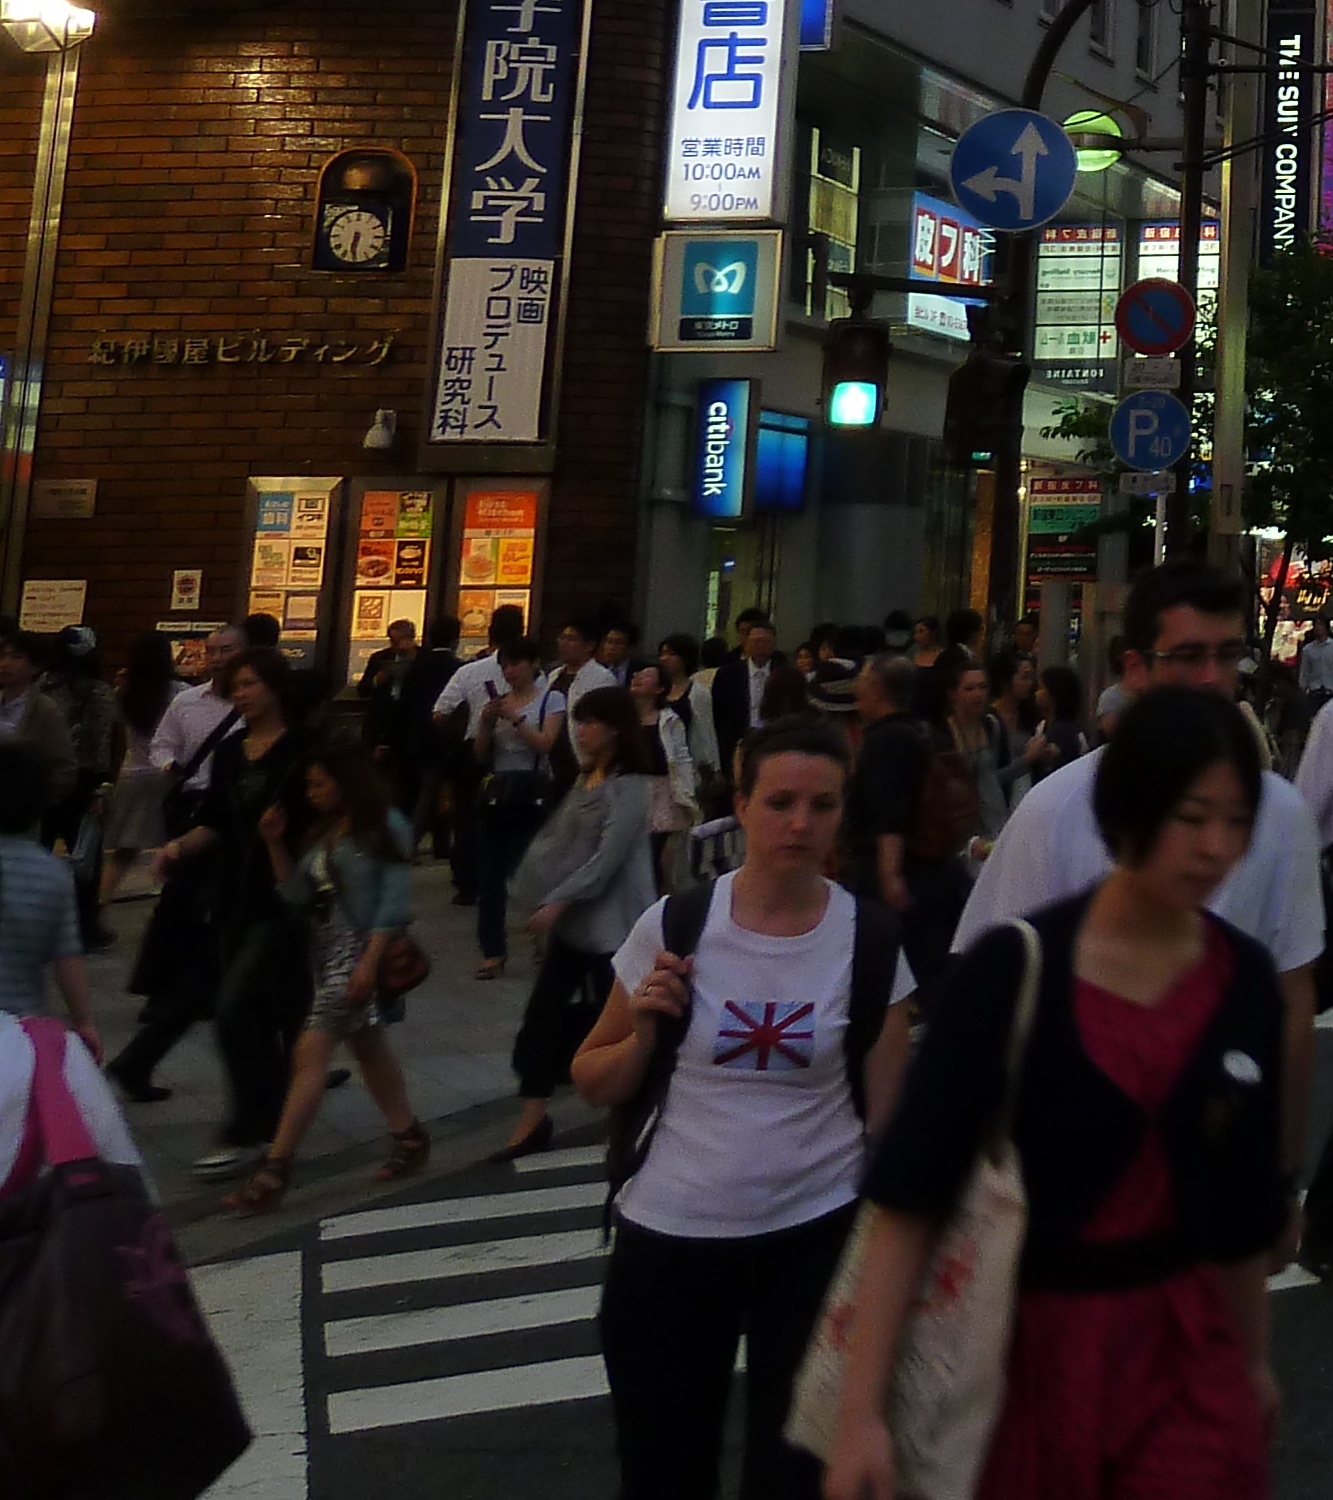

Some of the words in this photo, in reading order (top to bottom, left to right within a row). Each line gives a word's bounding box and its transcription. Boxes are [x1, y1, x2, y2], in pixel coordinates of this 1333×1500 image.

[680, 137, 766, 158] 営業時間
[681, 162, 762, 182] 10:00AM
[689, 192, 760, 211] 9:00PM
[517, 266, 549, 325] 映画
[474, 264, 519, 430] プロデュース
[436, 346, 477, 436] 研究科
[701, 401, 728, 498] citibank
[1127, 409, 1160, 458] P
